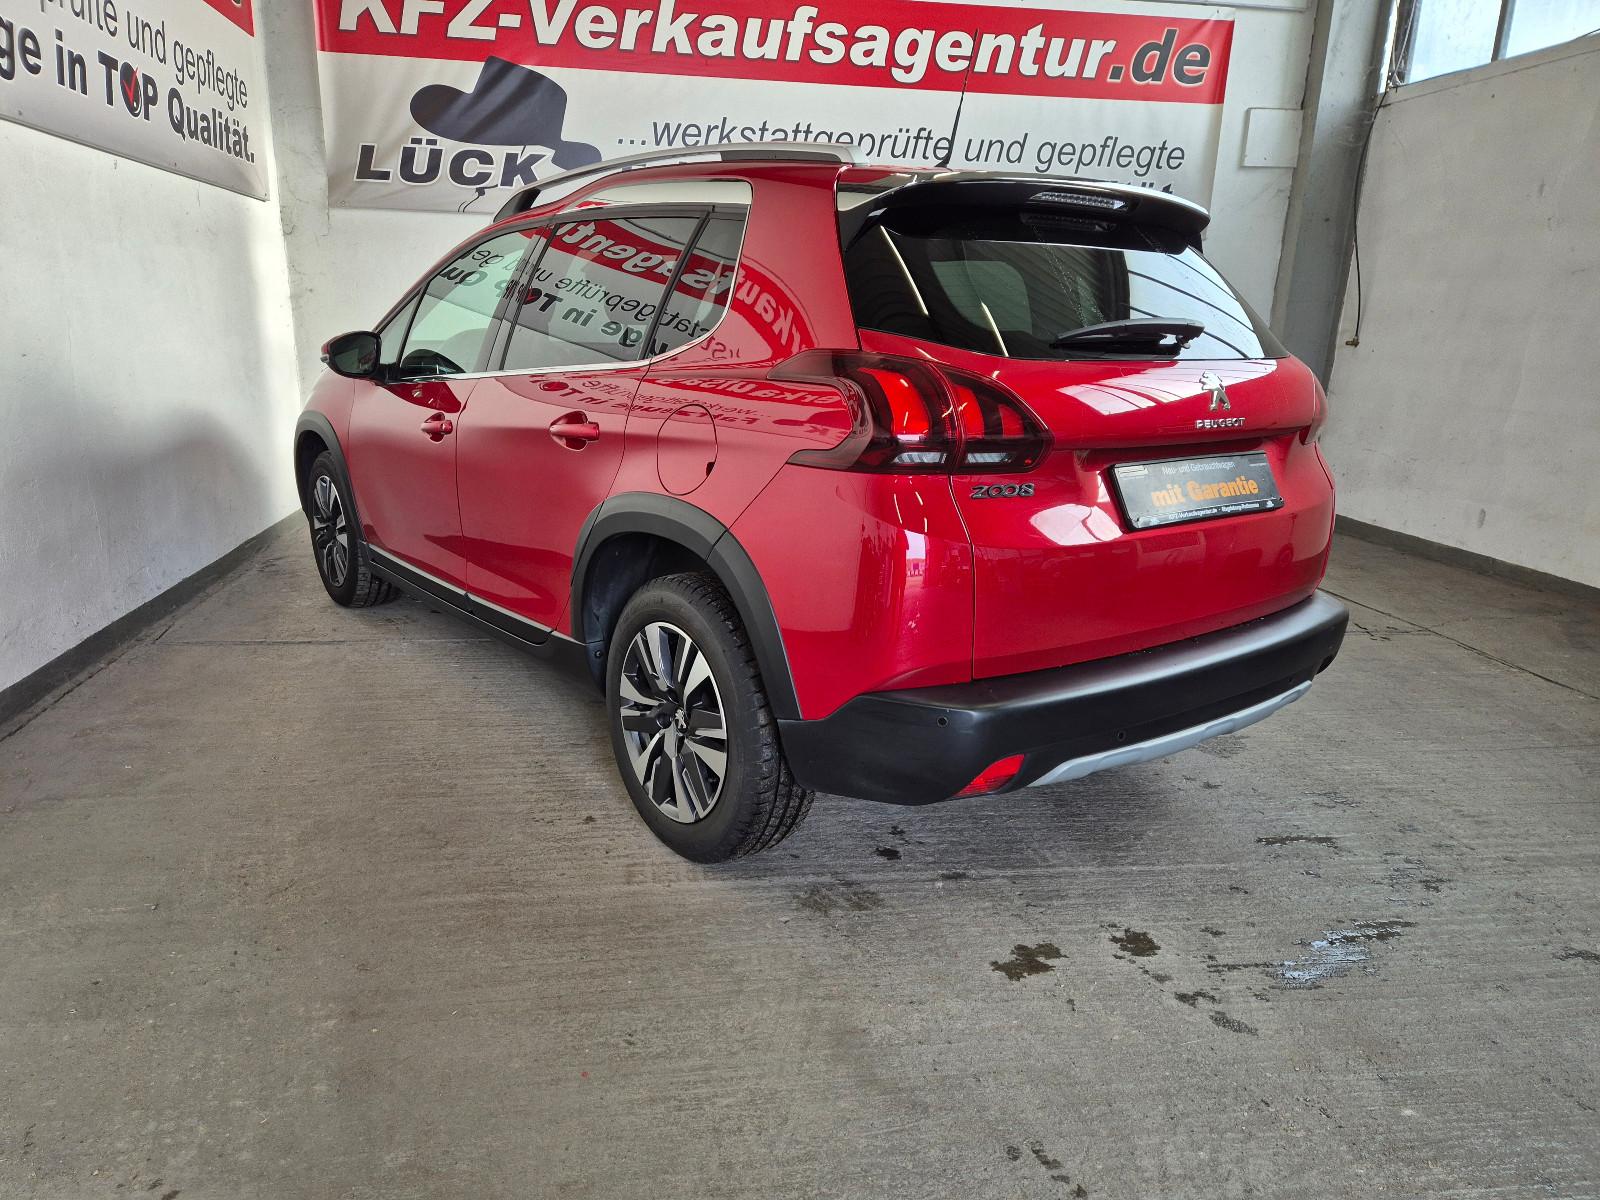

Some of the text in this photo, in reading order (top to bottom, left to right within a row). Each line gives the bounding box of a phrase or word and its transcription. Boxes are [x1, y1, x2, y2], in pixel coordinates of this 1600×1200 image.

[127, 10, 167, 65] und
[173, 39, 248, 111] gepflegte
[55, 28, 88, 96] in
[98, 50, 158, 121] TOP
[168, 87, 255, 164] Qualität.
[355, 137, 552, 188] LÜCK
[965, 133, 1028, 165] und
[1035, 136, 1185, 177] gepflegte
[1195, 417, 1246, 429] PEUGEOT
[970, 483, 1035, 499] 2008
[1151, 475, 1259, 507] mit Garantie
